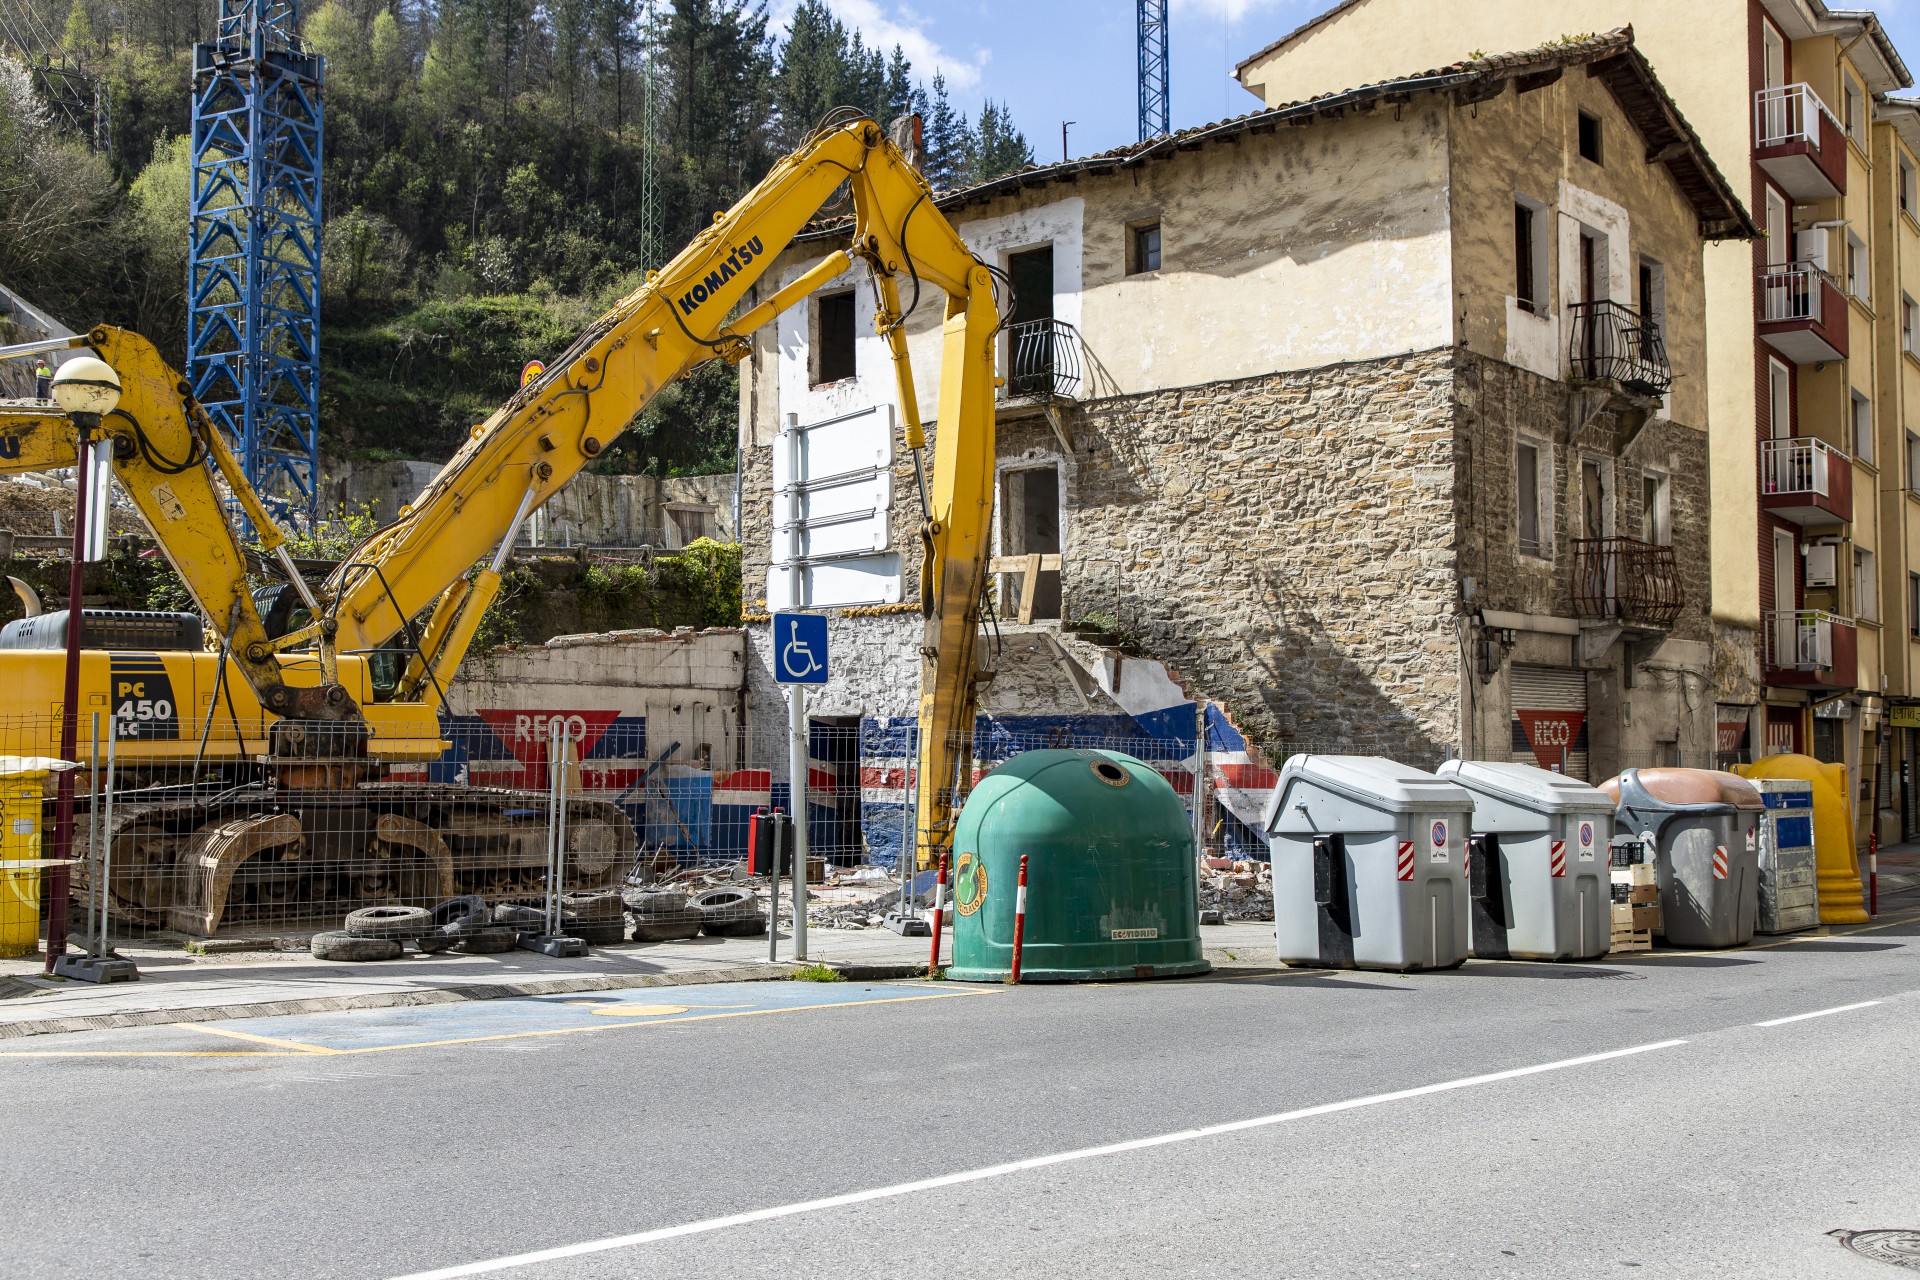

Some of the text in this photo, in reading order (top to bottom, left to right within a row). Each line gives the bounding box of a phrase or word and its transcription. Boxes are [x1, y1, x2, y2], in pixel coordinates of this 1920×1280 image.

[678, 235, 763, 316] KOMATSU
[118, 682, 145, 698] PC
[117, 699, 172, 721] 450
[118, 722, 138, 736] LC
[515, 714, 587, 743] RECO
[1534, 719, 1570, 746] RECO
[1112, 929, 1157, 939] ECOVIDRIO
